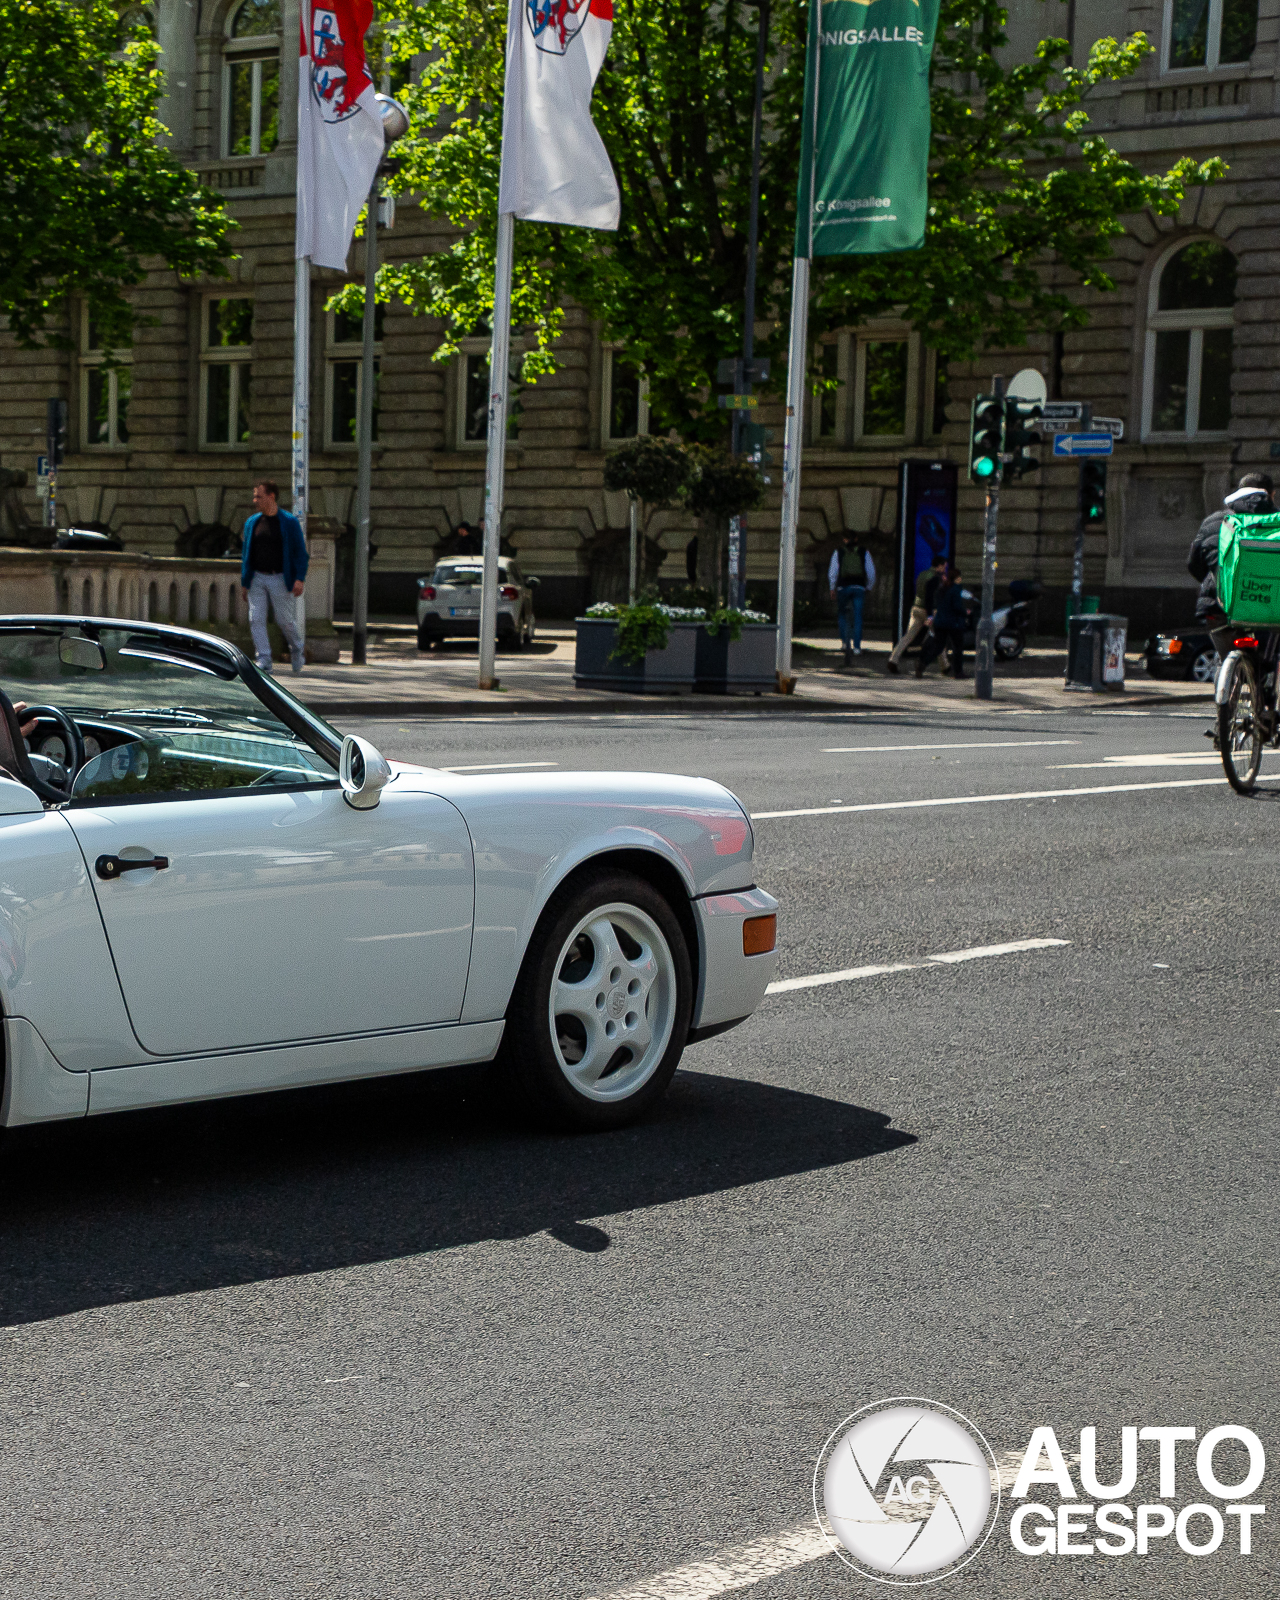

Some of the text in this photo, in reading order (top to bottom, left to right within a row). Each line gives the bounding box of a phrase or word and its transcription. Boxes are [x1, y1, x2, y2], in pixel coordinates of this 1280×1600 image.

[818, 25, 924, 47] NIGSALLEE
[1242, 578, 1273, 591] Uber
[1240, 590, 1271, 604] Eats
